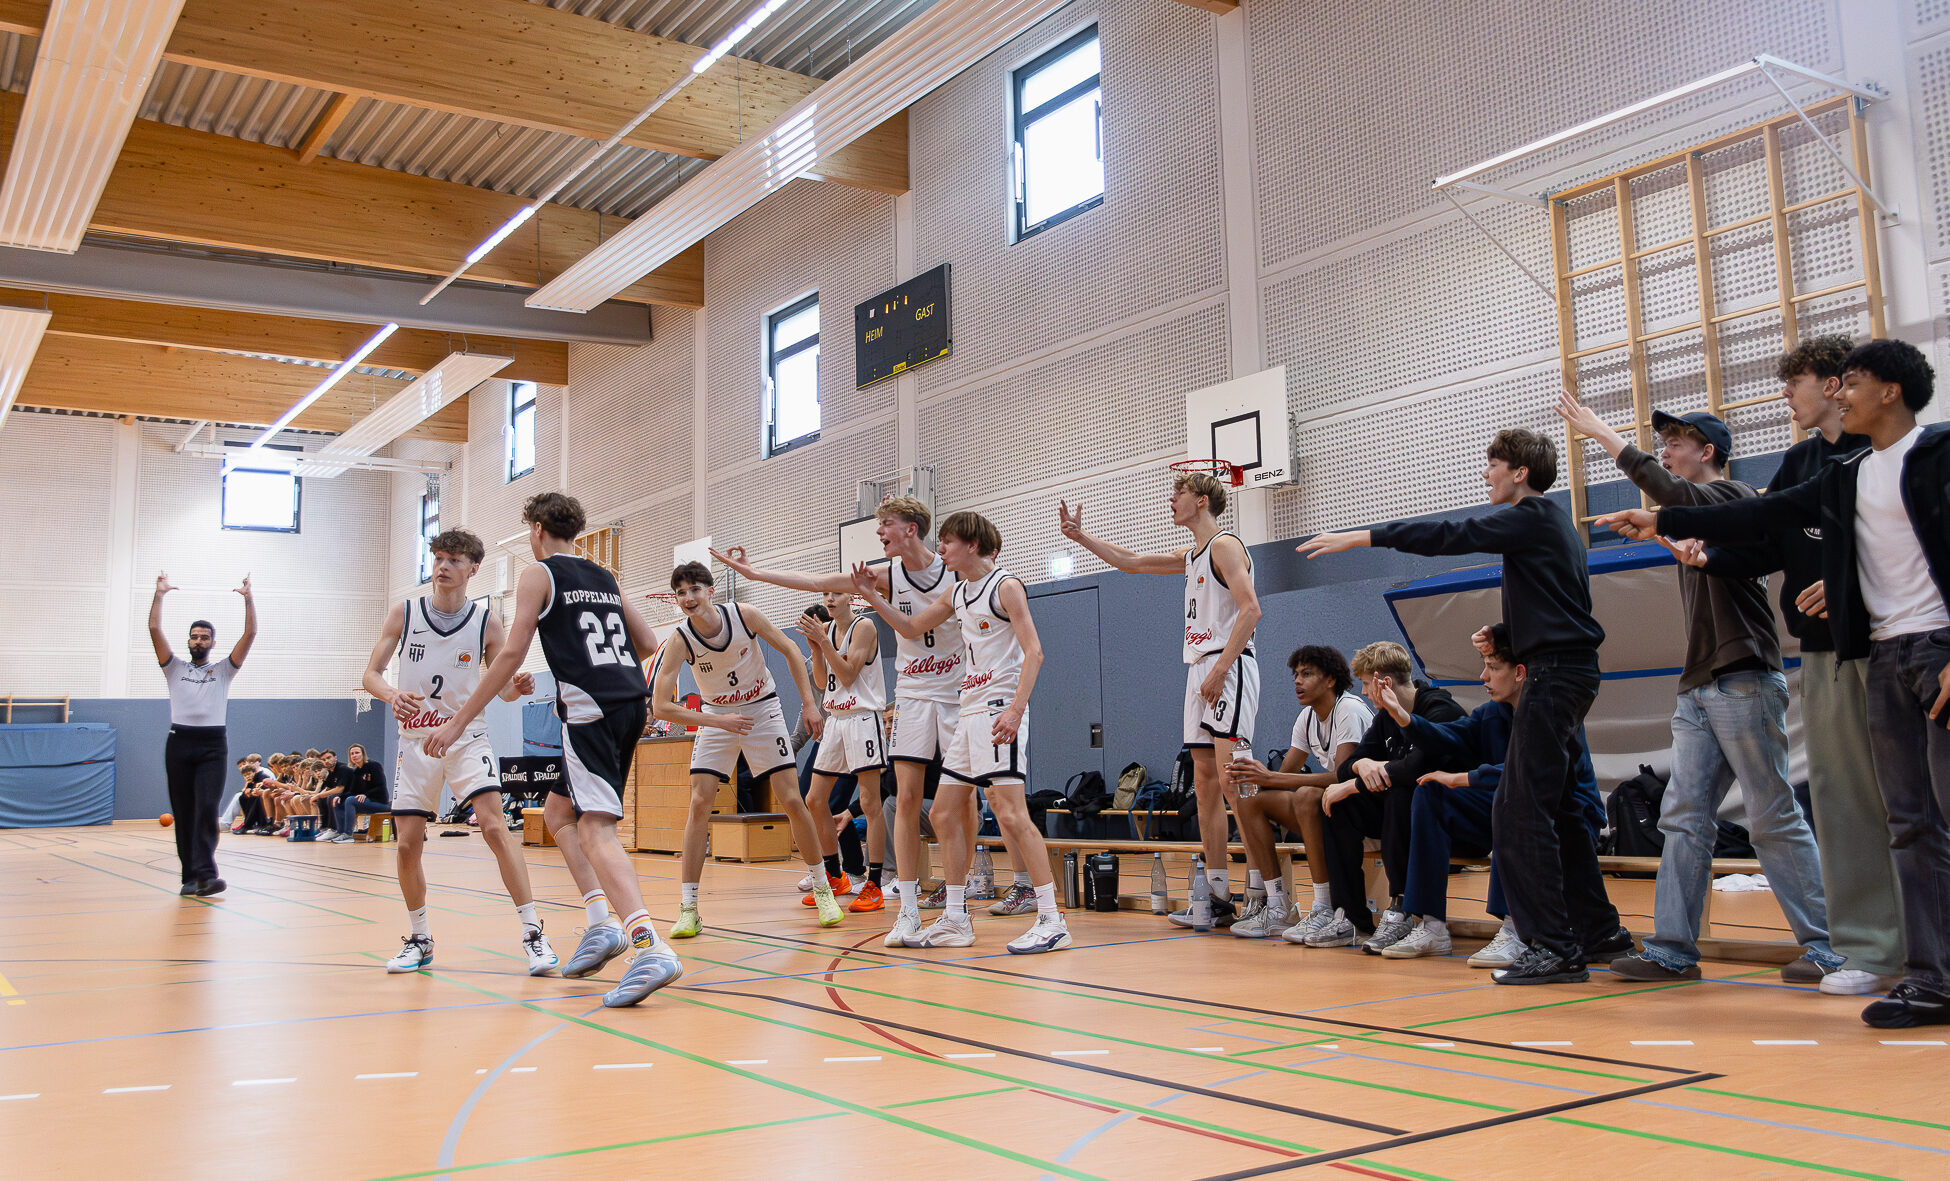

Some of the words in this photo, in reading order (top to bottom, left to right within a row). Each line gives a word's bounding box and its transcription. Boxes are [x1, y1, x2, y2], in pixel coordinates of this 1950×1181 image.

[915, 303, 935, 321] GAST
[865, 326, 883, 343] HEIM
[1254, 469, 1283, 481] BENZ
[579, 611, 637, 668] 22
[924, 629, 935, 648] 6
[409, 647, 425, 662] HH
[903, 653, 961, 675] Kellogg's
[430, 674, 444, 700] 2
[727, 670, 739, 687] 3
[828, 673, 836, 692] 8
[776, 736, 789, 757] 3
[865, 739, 875, 758] 8
[992, 742, 1000, 763] 1
[481, 755, 496, 778] 2
[533, 771, 560, 781] SPALDI
[501, 771, 527, 782] SPALDING
